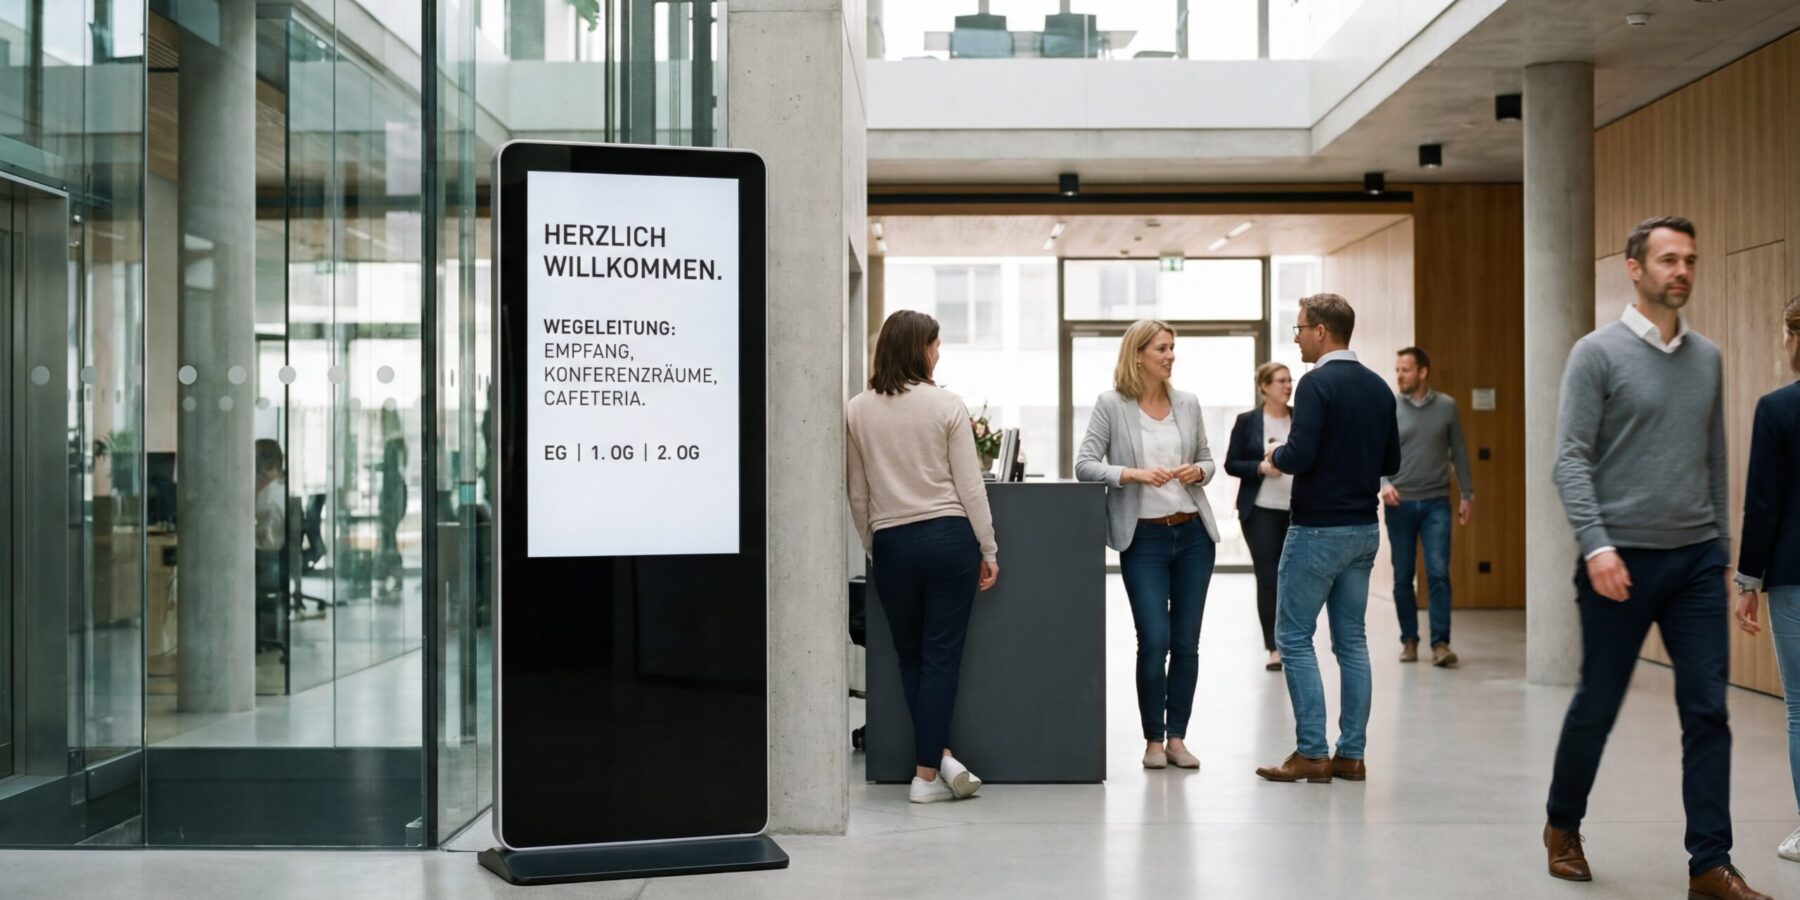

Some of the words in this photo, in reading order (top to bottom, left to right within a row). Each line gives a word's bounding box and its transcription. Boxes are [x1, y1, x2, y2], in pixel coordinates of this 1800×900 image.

[545, 224, 665, 247] HERZLICH
[544, 255, 722, 280] WILLKOMMEN.
[544, 319, 675, 335] WEGELEITUNG:
[545, 343, 633, 361] EMPFANG,
[545, 364, 717, 384] KONFERENZRÄUME,
[545, 390, 645, 406] CAFETERIA.
[545, 445, 566, 460] EG
[592, 445, 605, 460] 1.
[611, 445, 633, 460] OG
[658, 445, 671, 460] 2.
[677, 445, 699, 460] OG
